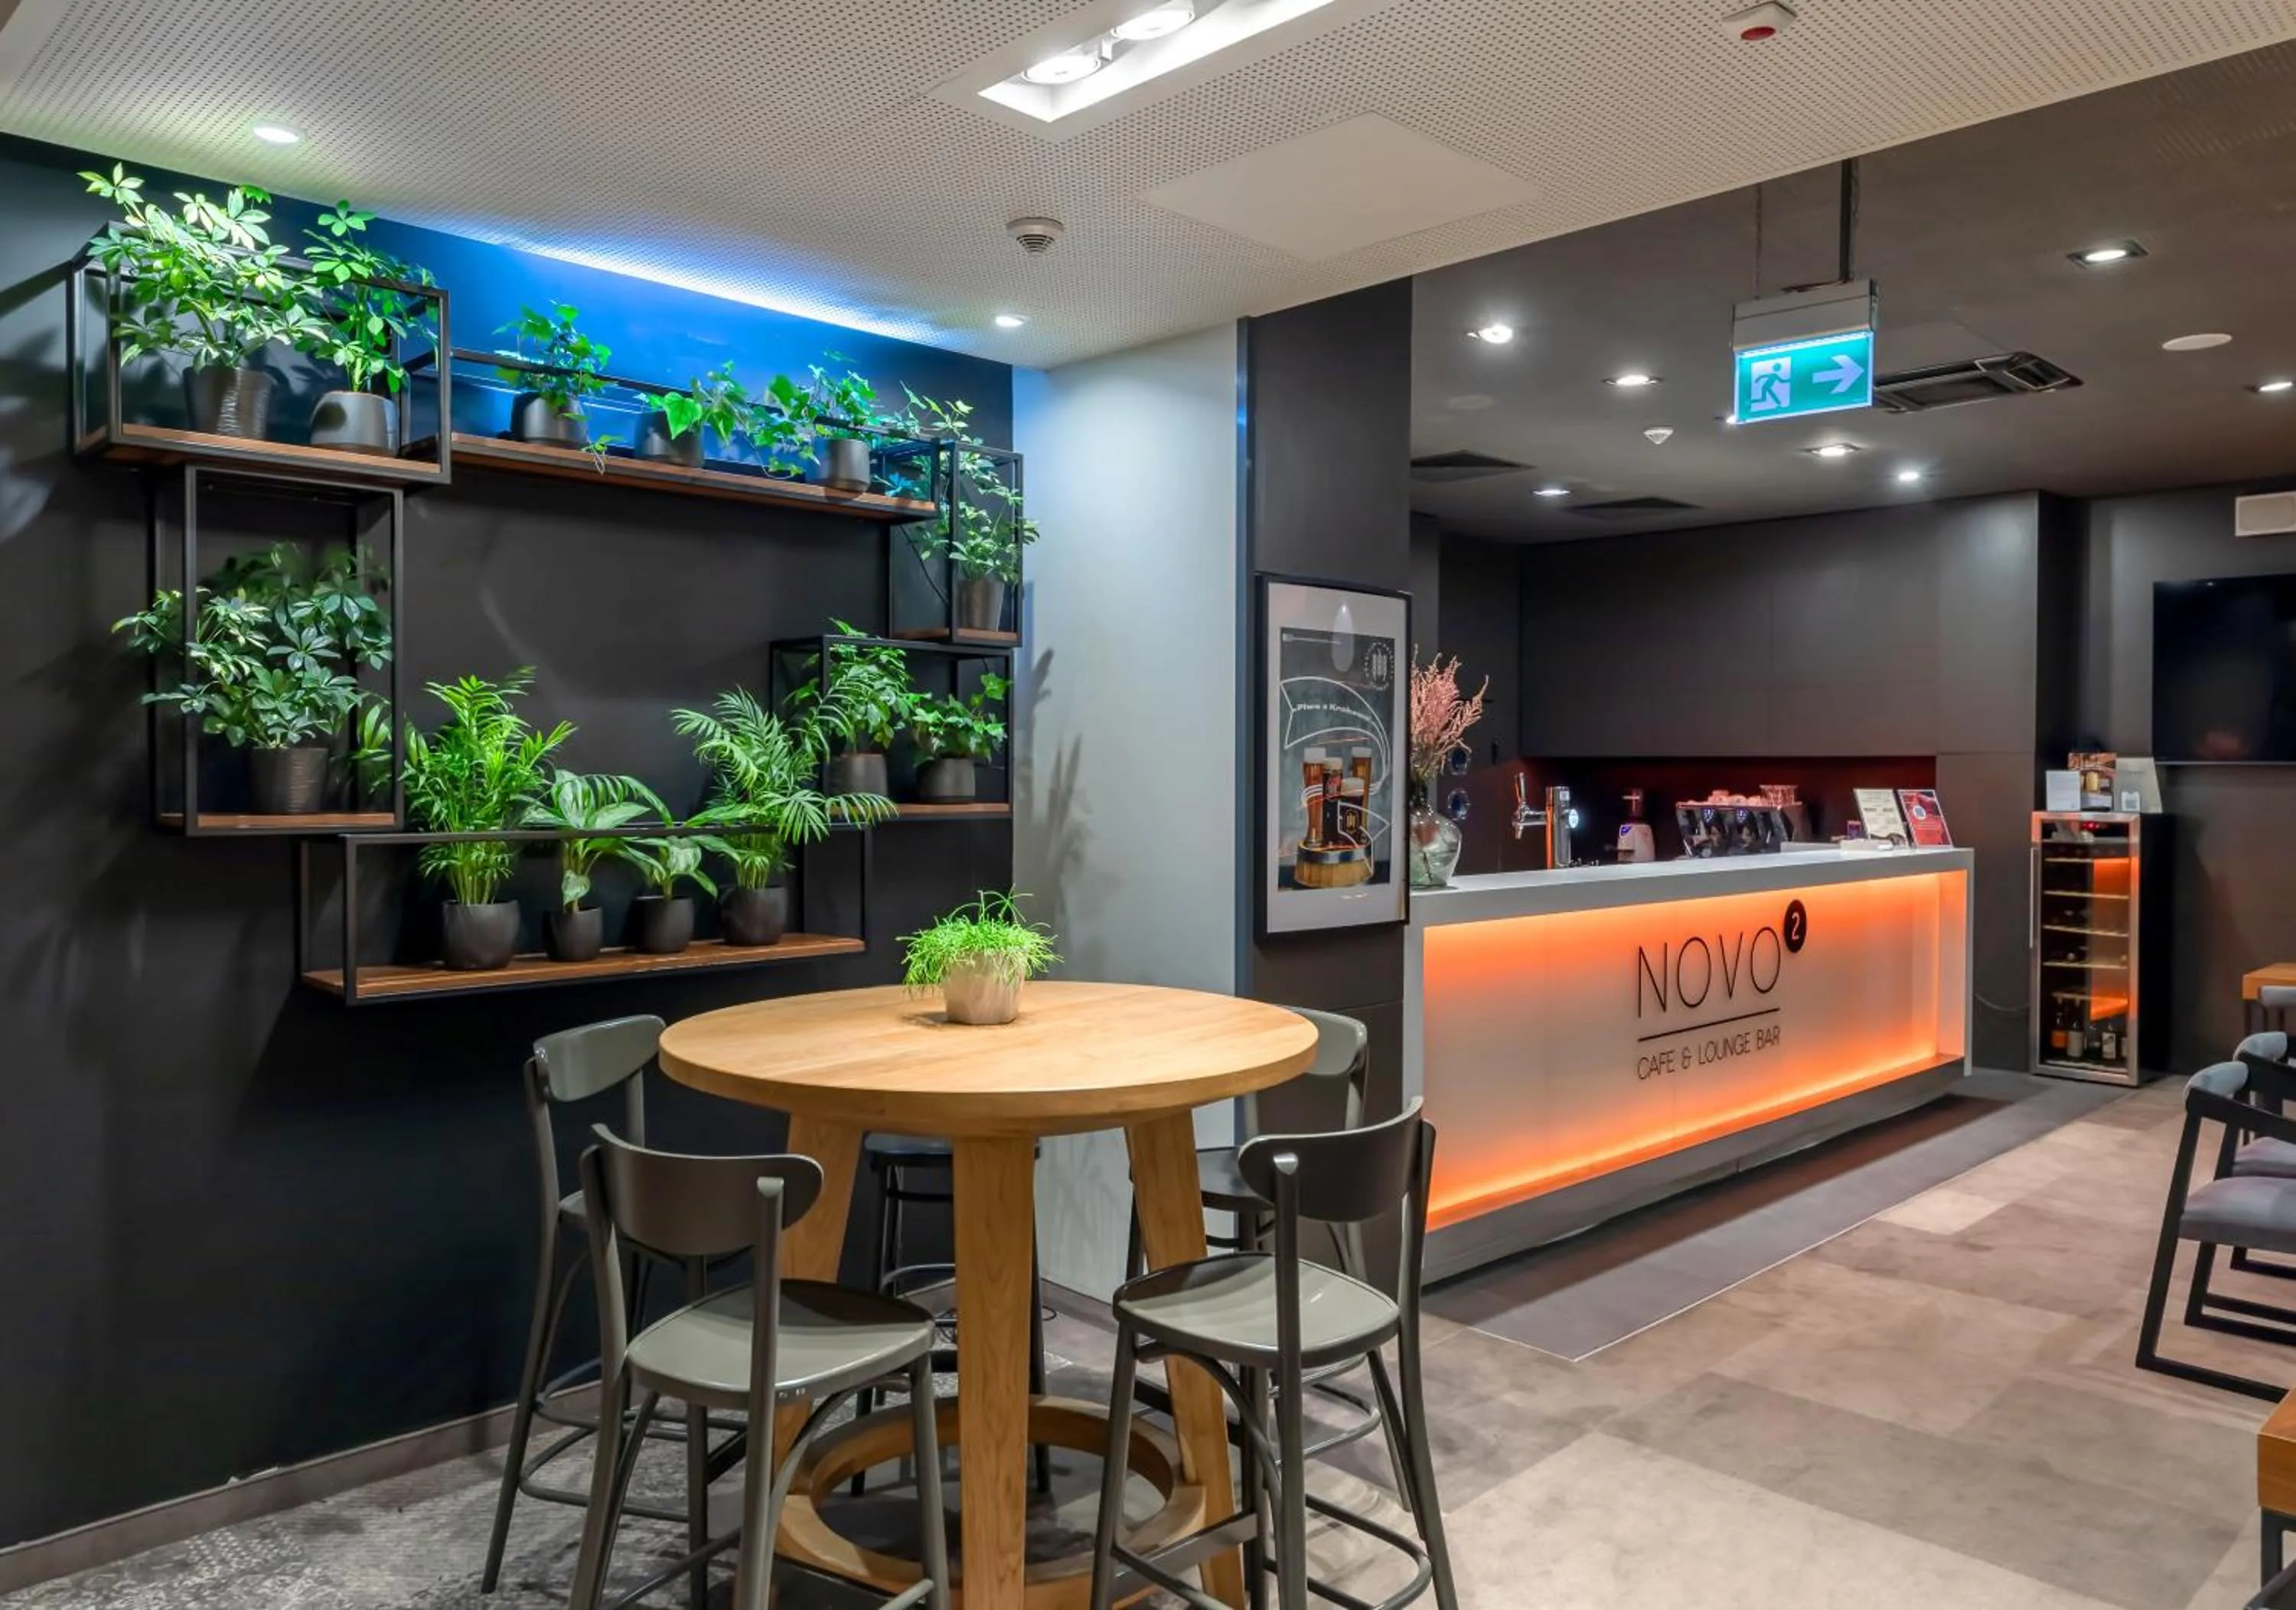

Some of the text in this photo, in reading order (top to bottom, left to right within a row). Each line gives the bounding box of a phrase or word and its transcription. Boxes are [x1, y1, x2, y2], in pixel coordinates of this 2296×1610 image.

[1637, 926, 1781, 1018] NOVO
[1637, 1025, 1781, 1080] CAFE & LOUNGE BAR
